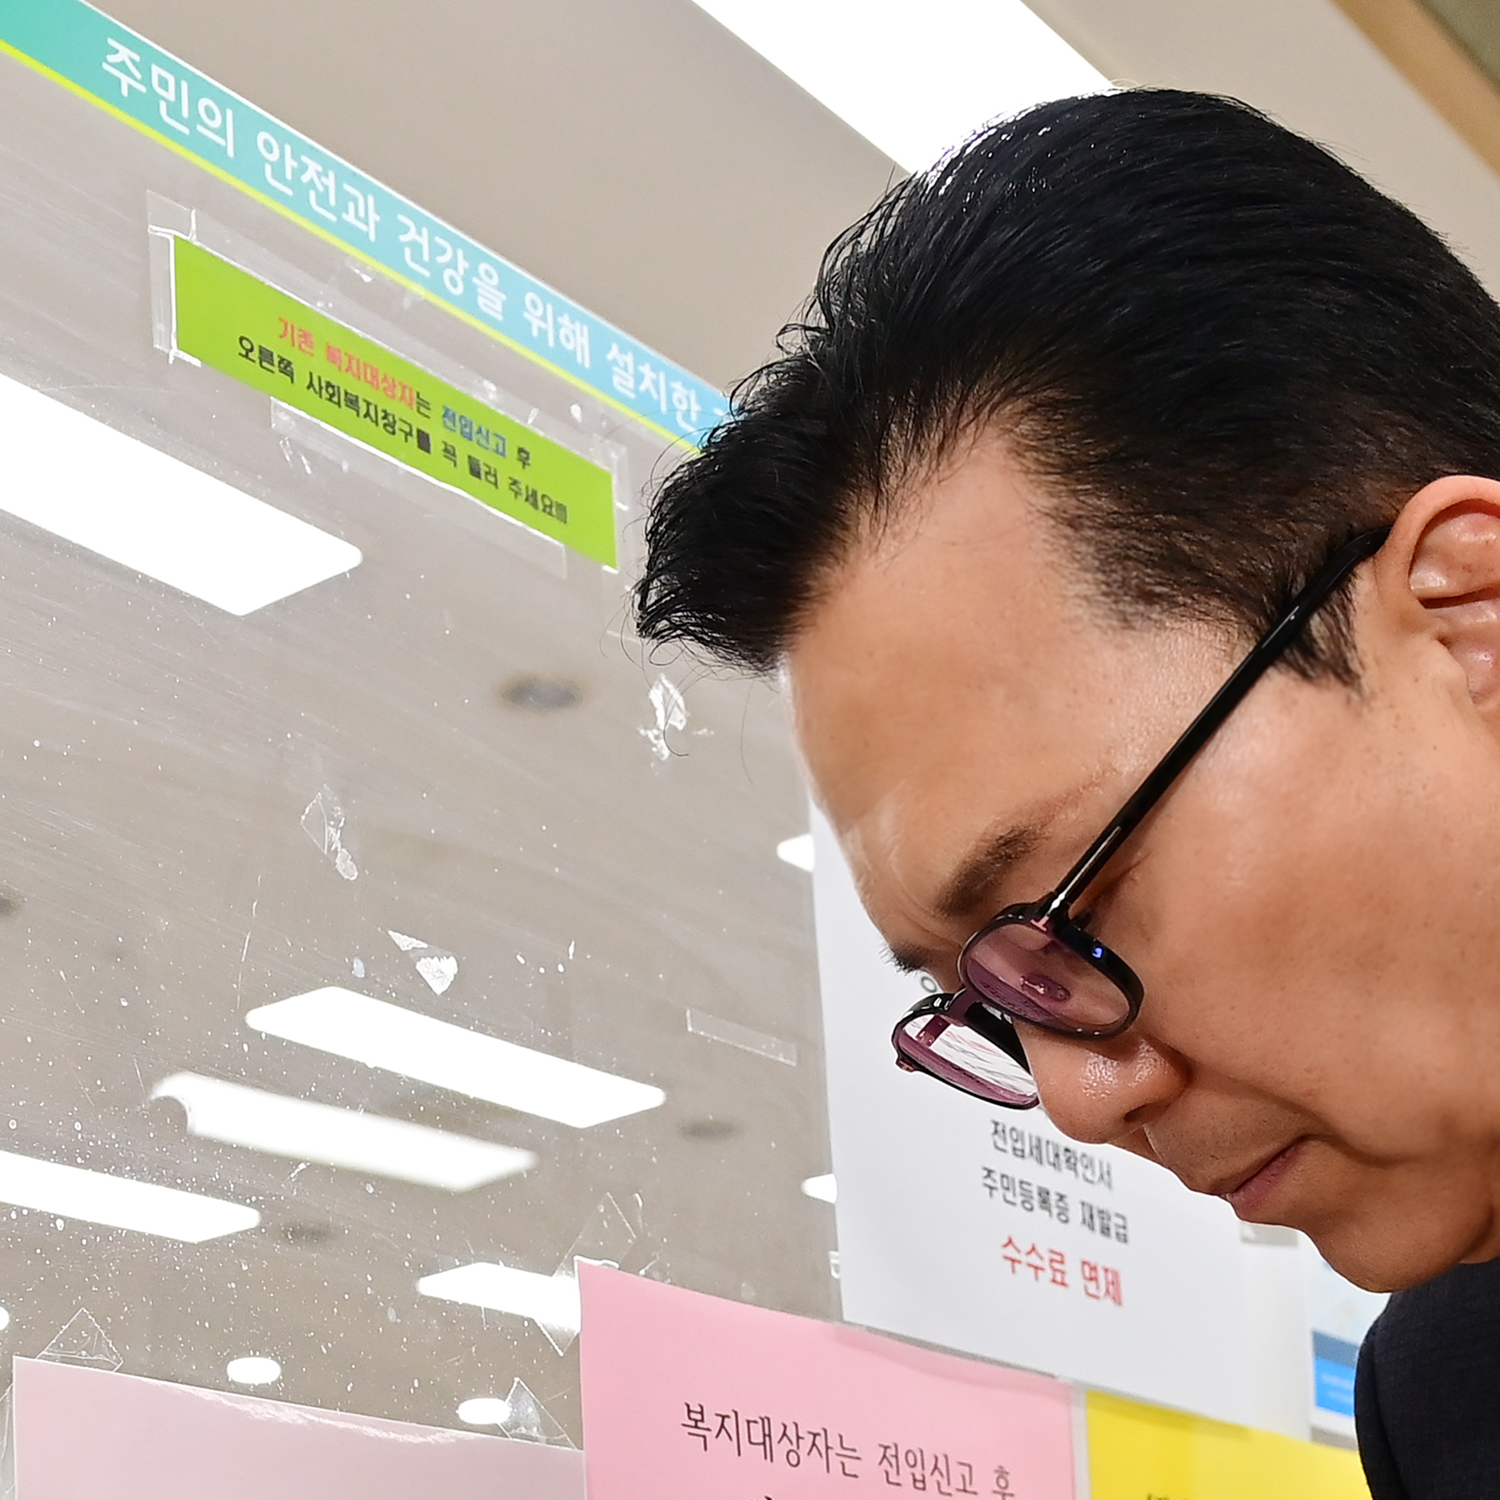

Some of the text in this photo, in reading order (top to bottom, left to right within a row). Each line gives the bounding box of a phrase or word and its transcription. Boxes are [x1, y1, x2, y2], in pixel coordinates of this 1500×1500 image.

[102, 37, 699, 433] 주민의 안전과 건강을 위해 설치한
[238, 335, 295, 383] 오른쪽
[307, 371, 431, 454] 사회복지창구를
[442, 440, 458, 467] 꼭
[467, 454, 499, 489] 들러
[278, 317, 531, 469] 기존 복지대상자는 전입신고 후
[990, 1119, 1113, 1191] 전입세대확인서
[981, 1167, 1130, 1244] 주민등록증 재발급
[1002, 1235, 1124, 1307] 수수료 면제
[682, 1402, 861, 1479] 복지대상자는
[878, 1442, 978, 1497] 전입신고
